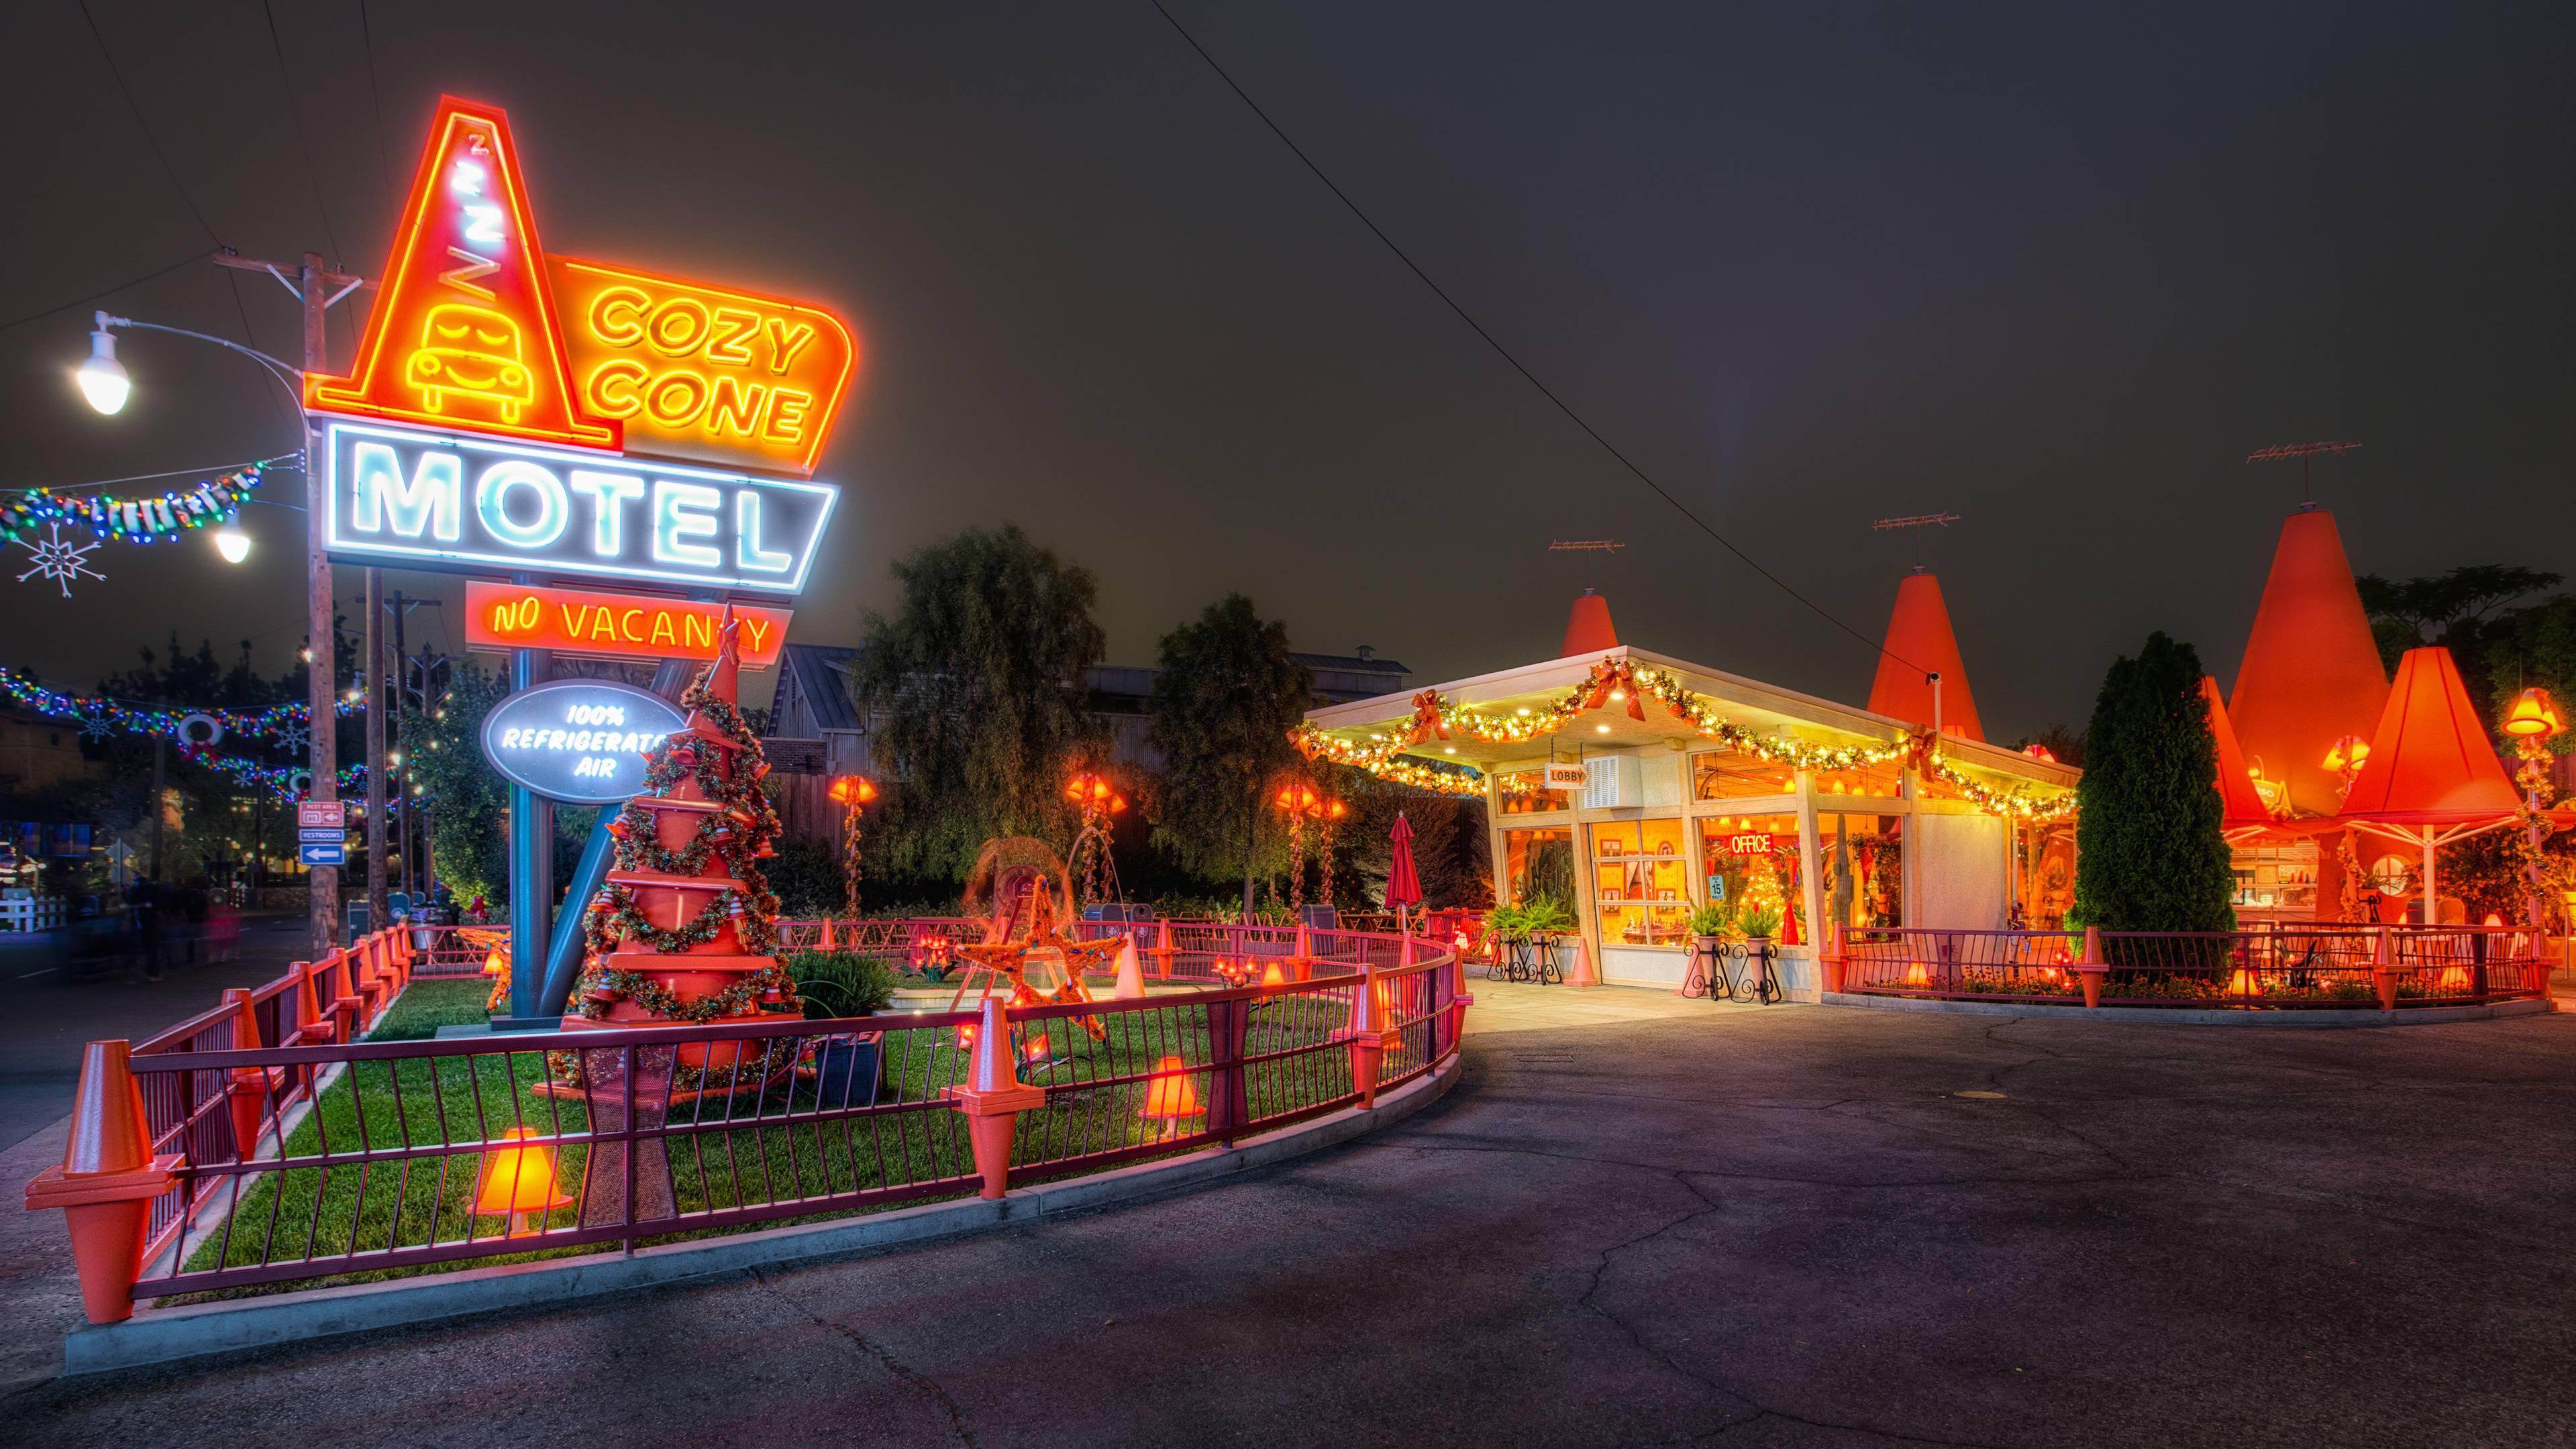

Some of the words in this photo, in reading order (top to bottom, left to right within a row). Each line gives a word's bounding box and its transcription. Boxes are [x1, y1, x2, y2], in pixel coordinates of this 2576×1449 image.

[588, 286, 815, 375] COZY
[586, 359, 813, 445] CONE
[354, 441, 792, 573] MOTEL
[494, 596, 539, 633] NO
[562, 604, 769, 653] VACANY
[566, 704, 624, 726] 100%
[574, 756, 617, 778] AIR
[1551, 771, 1584, 782] LOBBY
[1732, 835, 1771, 853] OFFICE
[1712, 883, 1721, 895] 15
